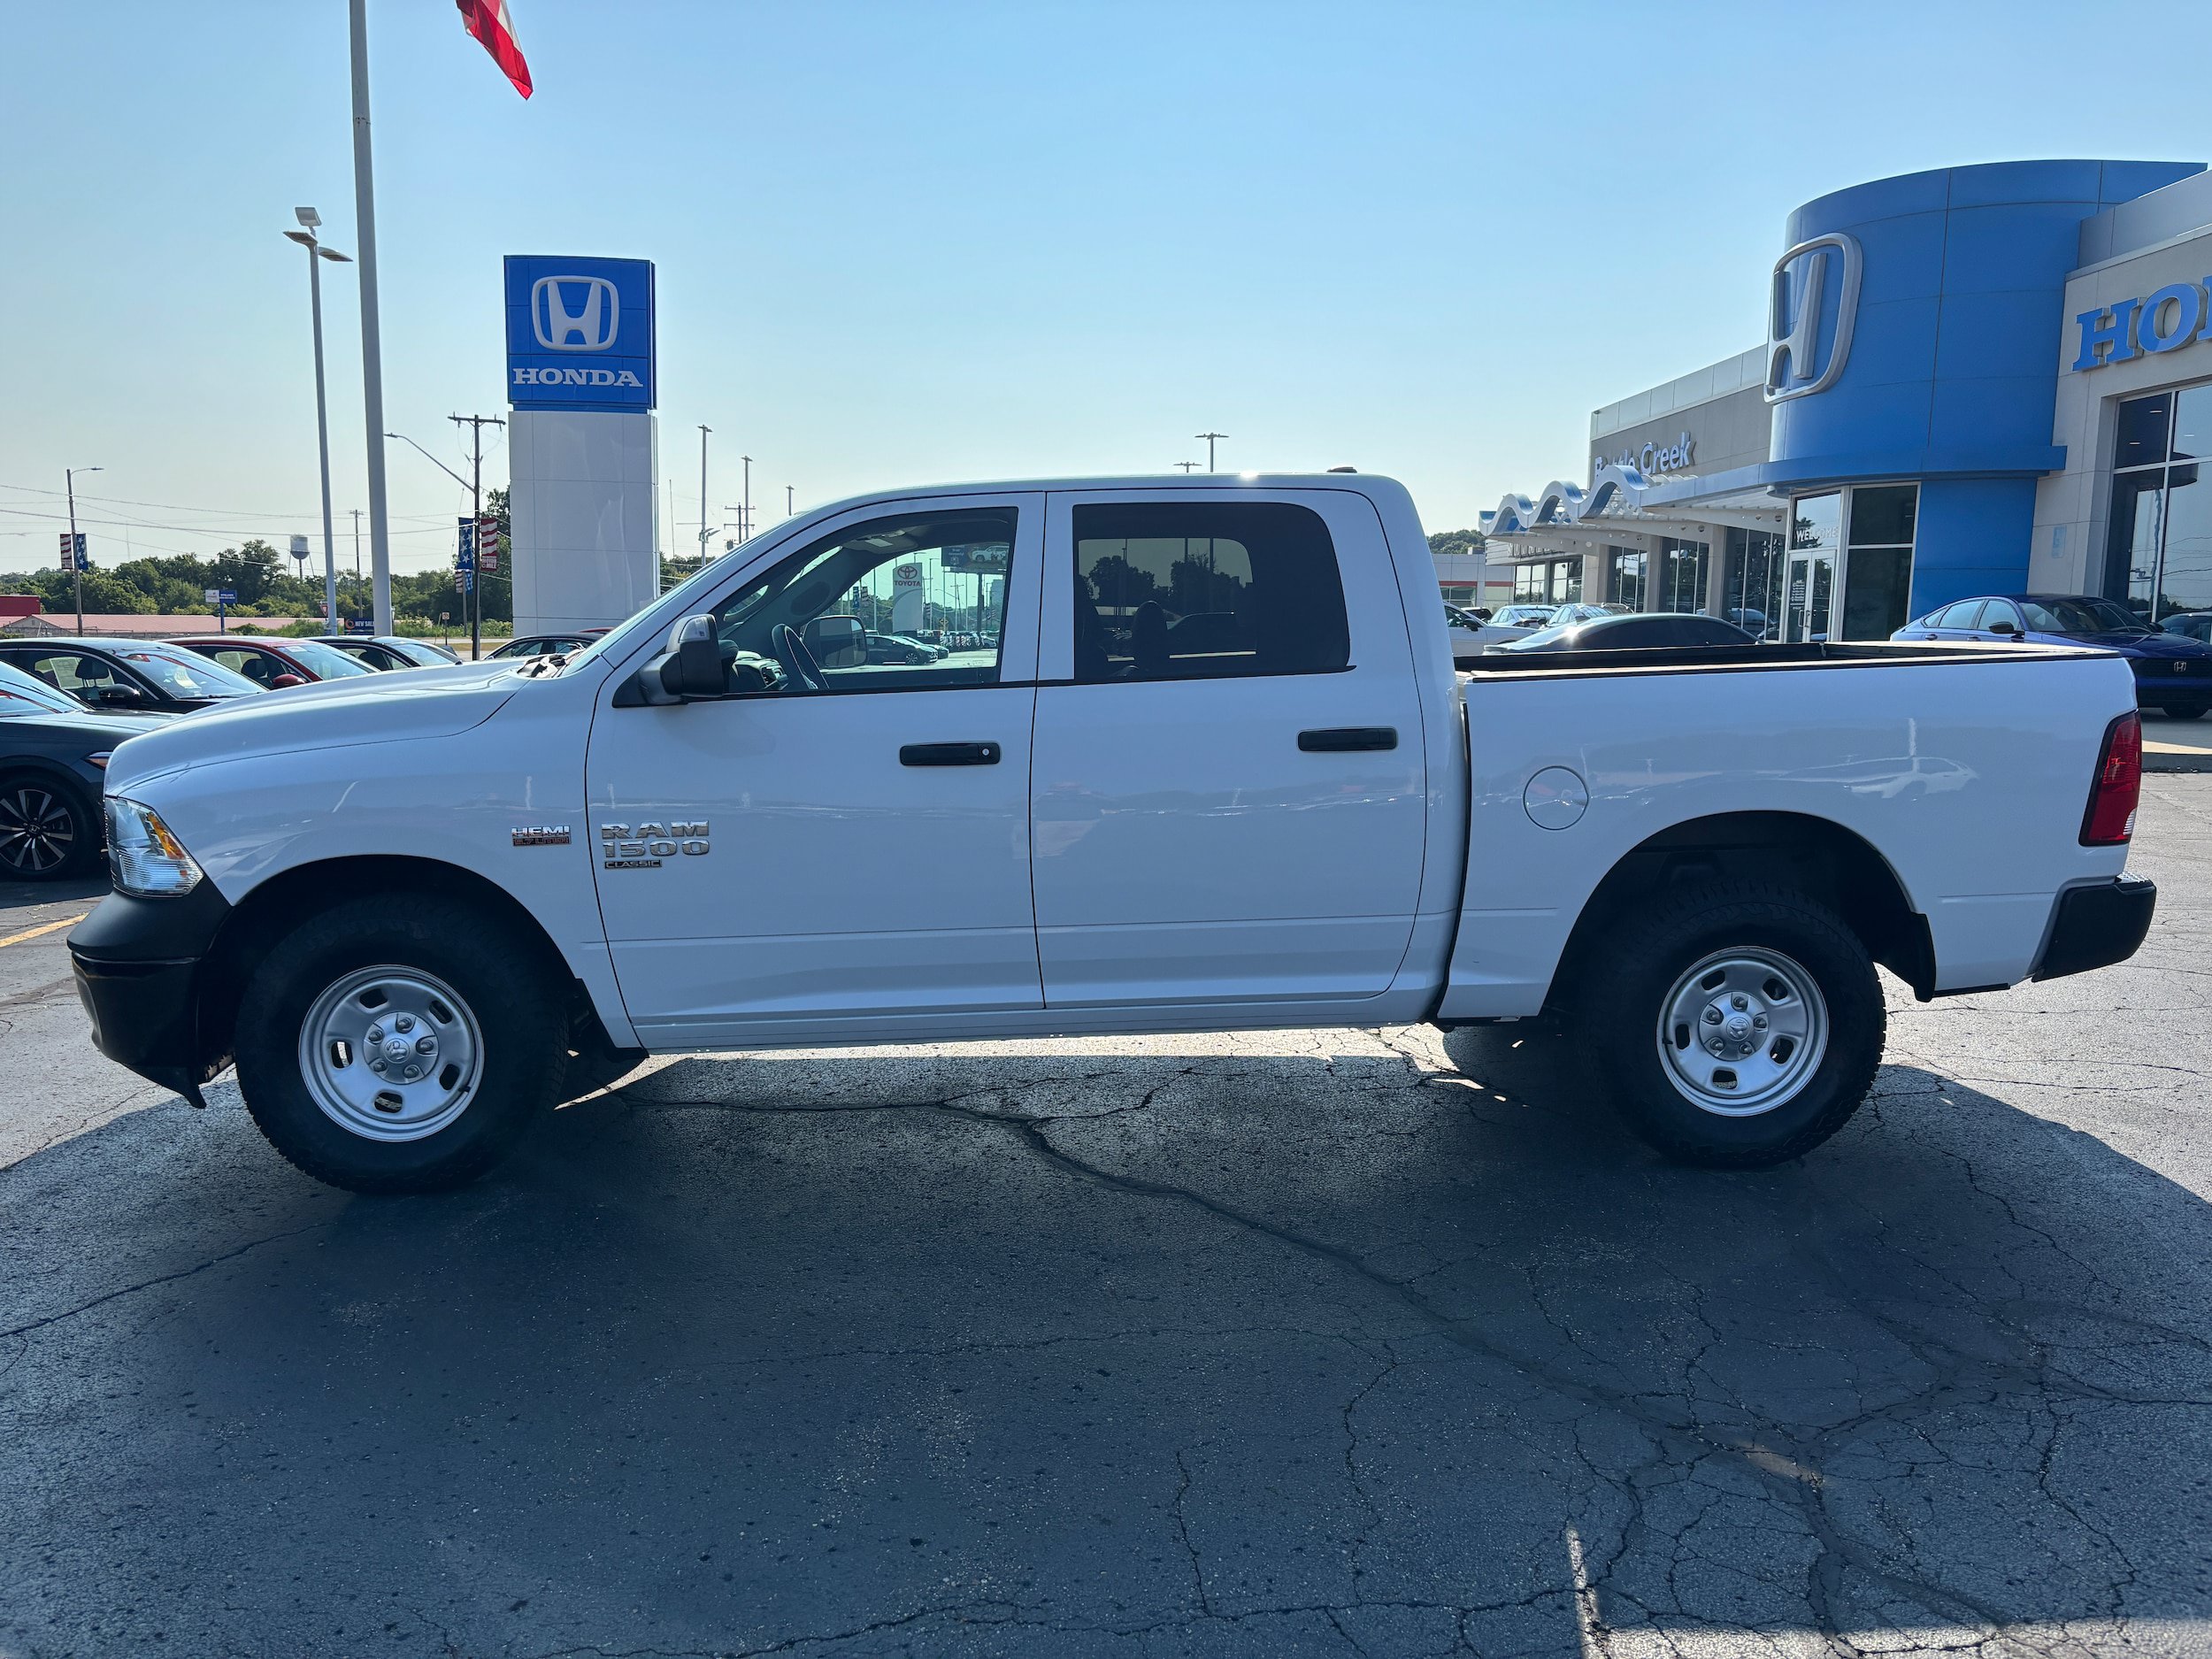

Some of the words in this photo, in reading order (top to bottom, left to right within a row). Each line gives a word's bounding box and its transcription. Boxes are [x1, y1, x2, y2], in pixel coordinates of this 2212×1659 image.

[2072, 275, 2212, 372] HO
[512, 368, 644, 387] HONDA
[1640, 432, 1692, 475] Creek
[511, 826, 570, 836] HEMI
[601, 820, 710, 839] RAM
[603, 840, 710, 858] 1500
[605, 860, 662, 869] CLASSIC
